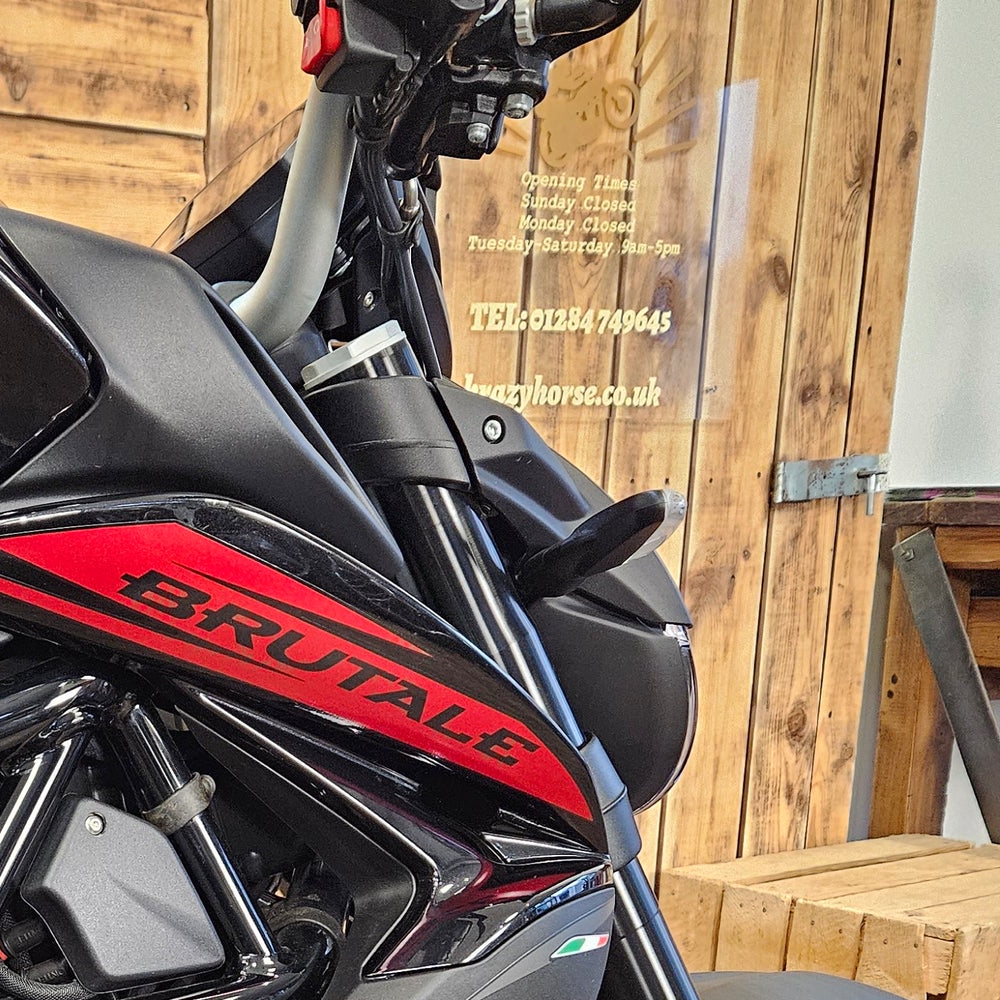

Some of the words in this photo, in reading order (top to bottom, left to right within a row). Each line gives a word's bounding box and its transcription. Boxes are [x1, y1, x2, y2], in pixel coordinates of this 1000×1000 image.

[521, 171, 586, 193] Opening
[593, 174, 638, 191] Times
[520, 193, 576, 214] Sunday
[583, 195, 637, 212] Closed
[518, 214, 575, 236] Monday
[582, 217, 636, 233] Closed
[467, 235, 614, 257] Tuesday-Saturday
[620, 238, 682, 260] 9am-5pm
[596, 306, 672, 336] 749645
[119, 569, 541, 767] BRUTALE
